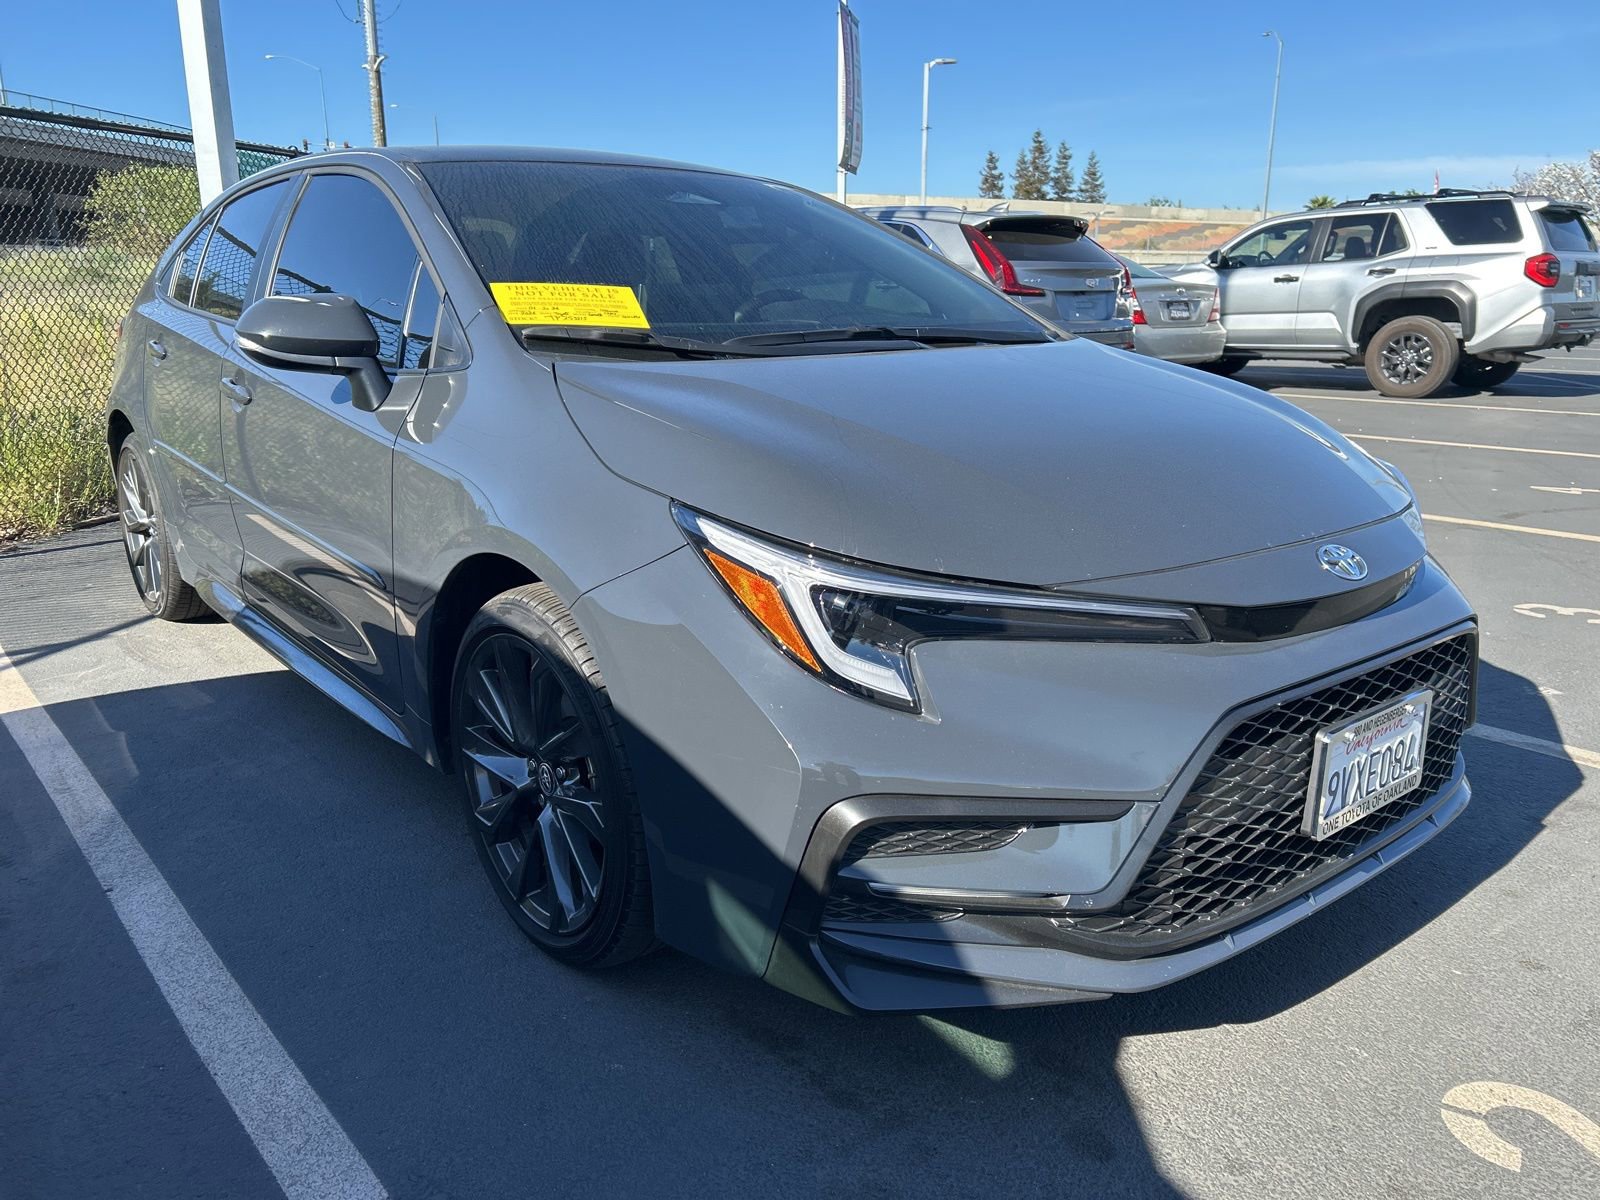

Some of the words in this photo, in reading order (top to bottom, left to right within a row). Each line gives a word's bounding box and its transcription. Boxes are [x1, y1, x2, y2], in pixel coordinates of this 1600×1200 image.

[542, 286, 602, 294] VEHICLE
[1346, 718, 1409, 755] California
[1323, 734, 1417, 820] 9VXE084
[1322, 817, 1339, 835] ONE
[1341, 803, 1371, 824] TOYOTA
[1372, 793, 1383, 808] OF
[1383, 775, 1418, 801] OAKLAND
